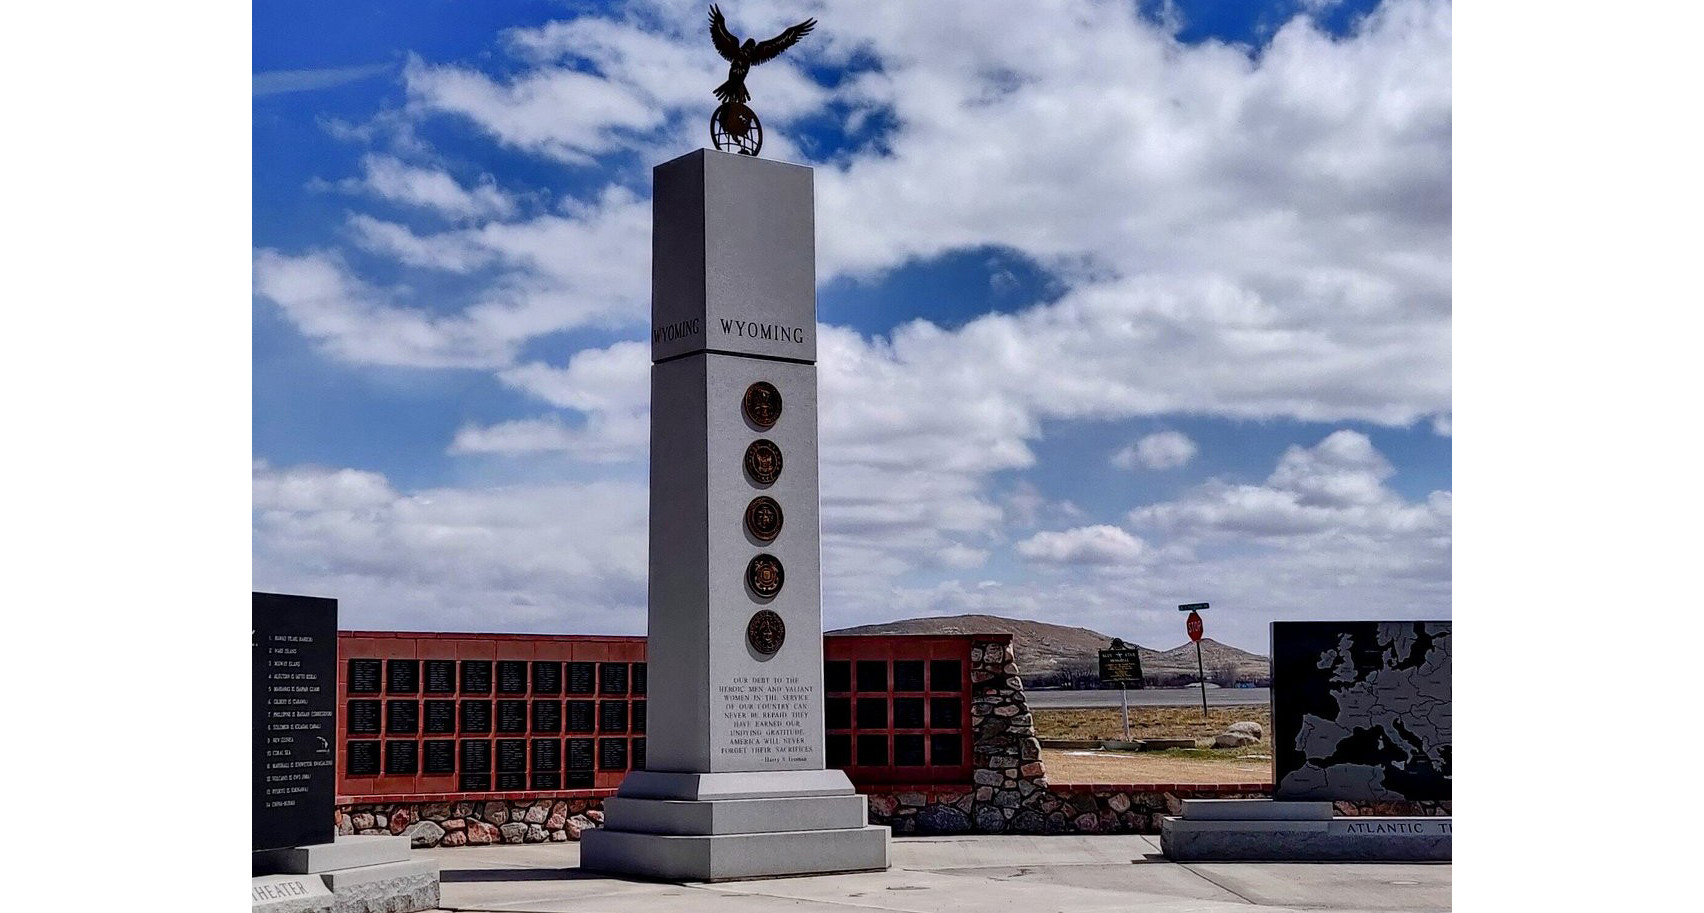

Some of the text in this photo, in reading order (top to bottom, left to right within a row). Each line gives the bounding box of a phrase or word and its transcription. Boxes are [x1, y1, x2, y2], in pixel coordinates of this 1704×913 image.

[654, 318, 699, 343] WYOMING
[720, 319, 803, 343] WYOMING
[1188, 620, 1201, 633] STOP
[1347, 823, 1424, 834] ATLANTIC
